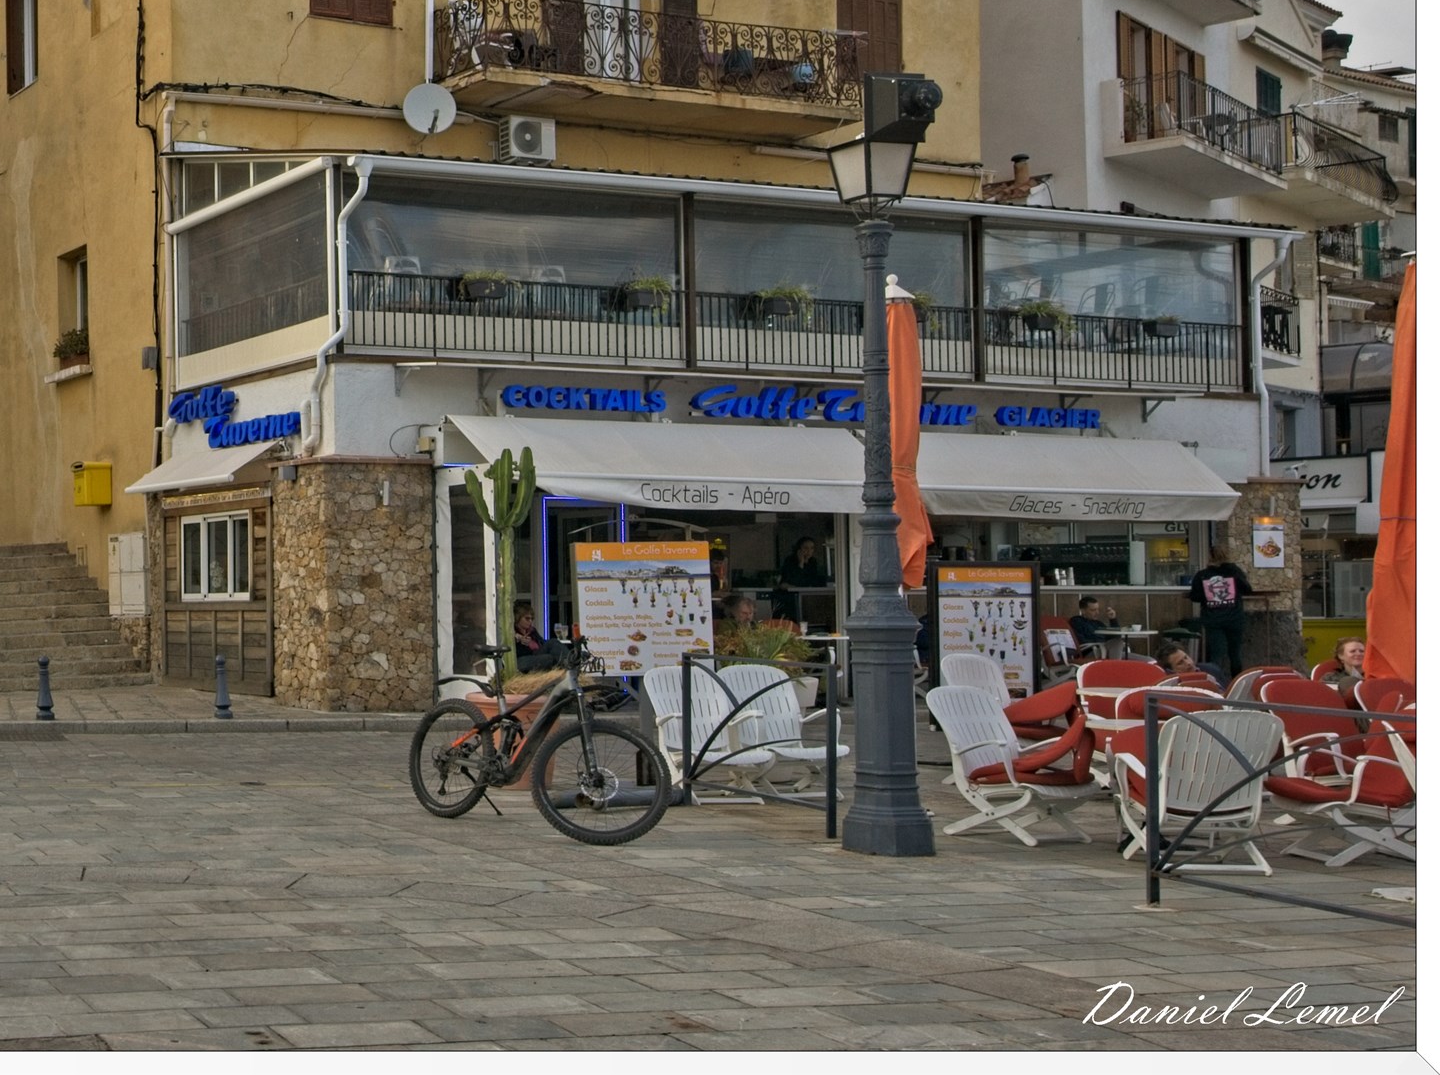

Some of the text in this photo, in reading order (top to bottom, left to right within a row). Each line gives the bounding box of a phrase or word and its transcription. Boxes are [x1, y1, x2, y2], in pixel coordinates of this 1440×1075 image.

[168, 384, 237, 424] Golfe
[501, 384, 668, 413] COCKTAILS
[690, 384, 818, 420] Golfe
[203, 410, 302, 449] Taverne
[995, 406, 1102, 429] GLACIER
[640, 483, 719, 504] Cocktails
[741, 485, 791, 508] Apéro
[1008, 495, 1063, 514] Glaces
[1082, 497, 1146, 519] Snacking
[622, 544, 633, 555] Le
[634, 544, 660, 555] Golfe
[662, 544, 699, 555] Taverne
[584, 585, 608, 593] Glaces
[584, 599, 615, 607] Cocktails
